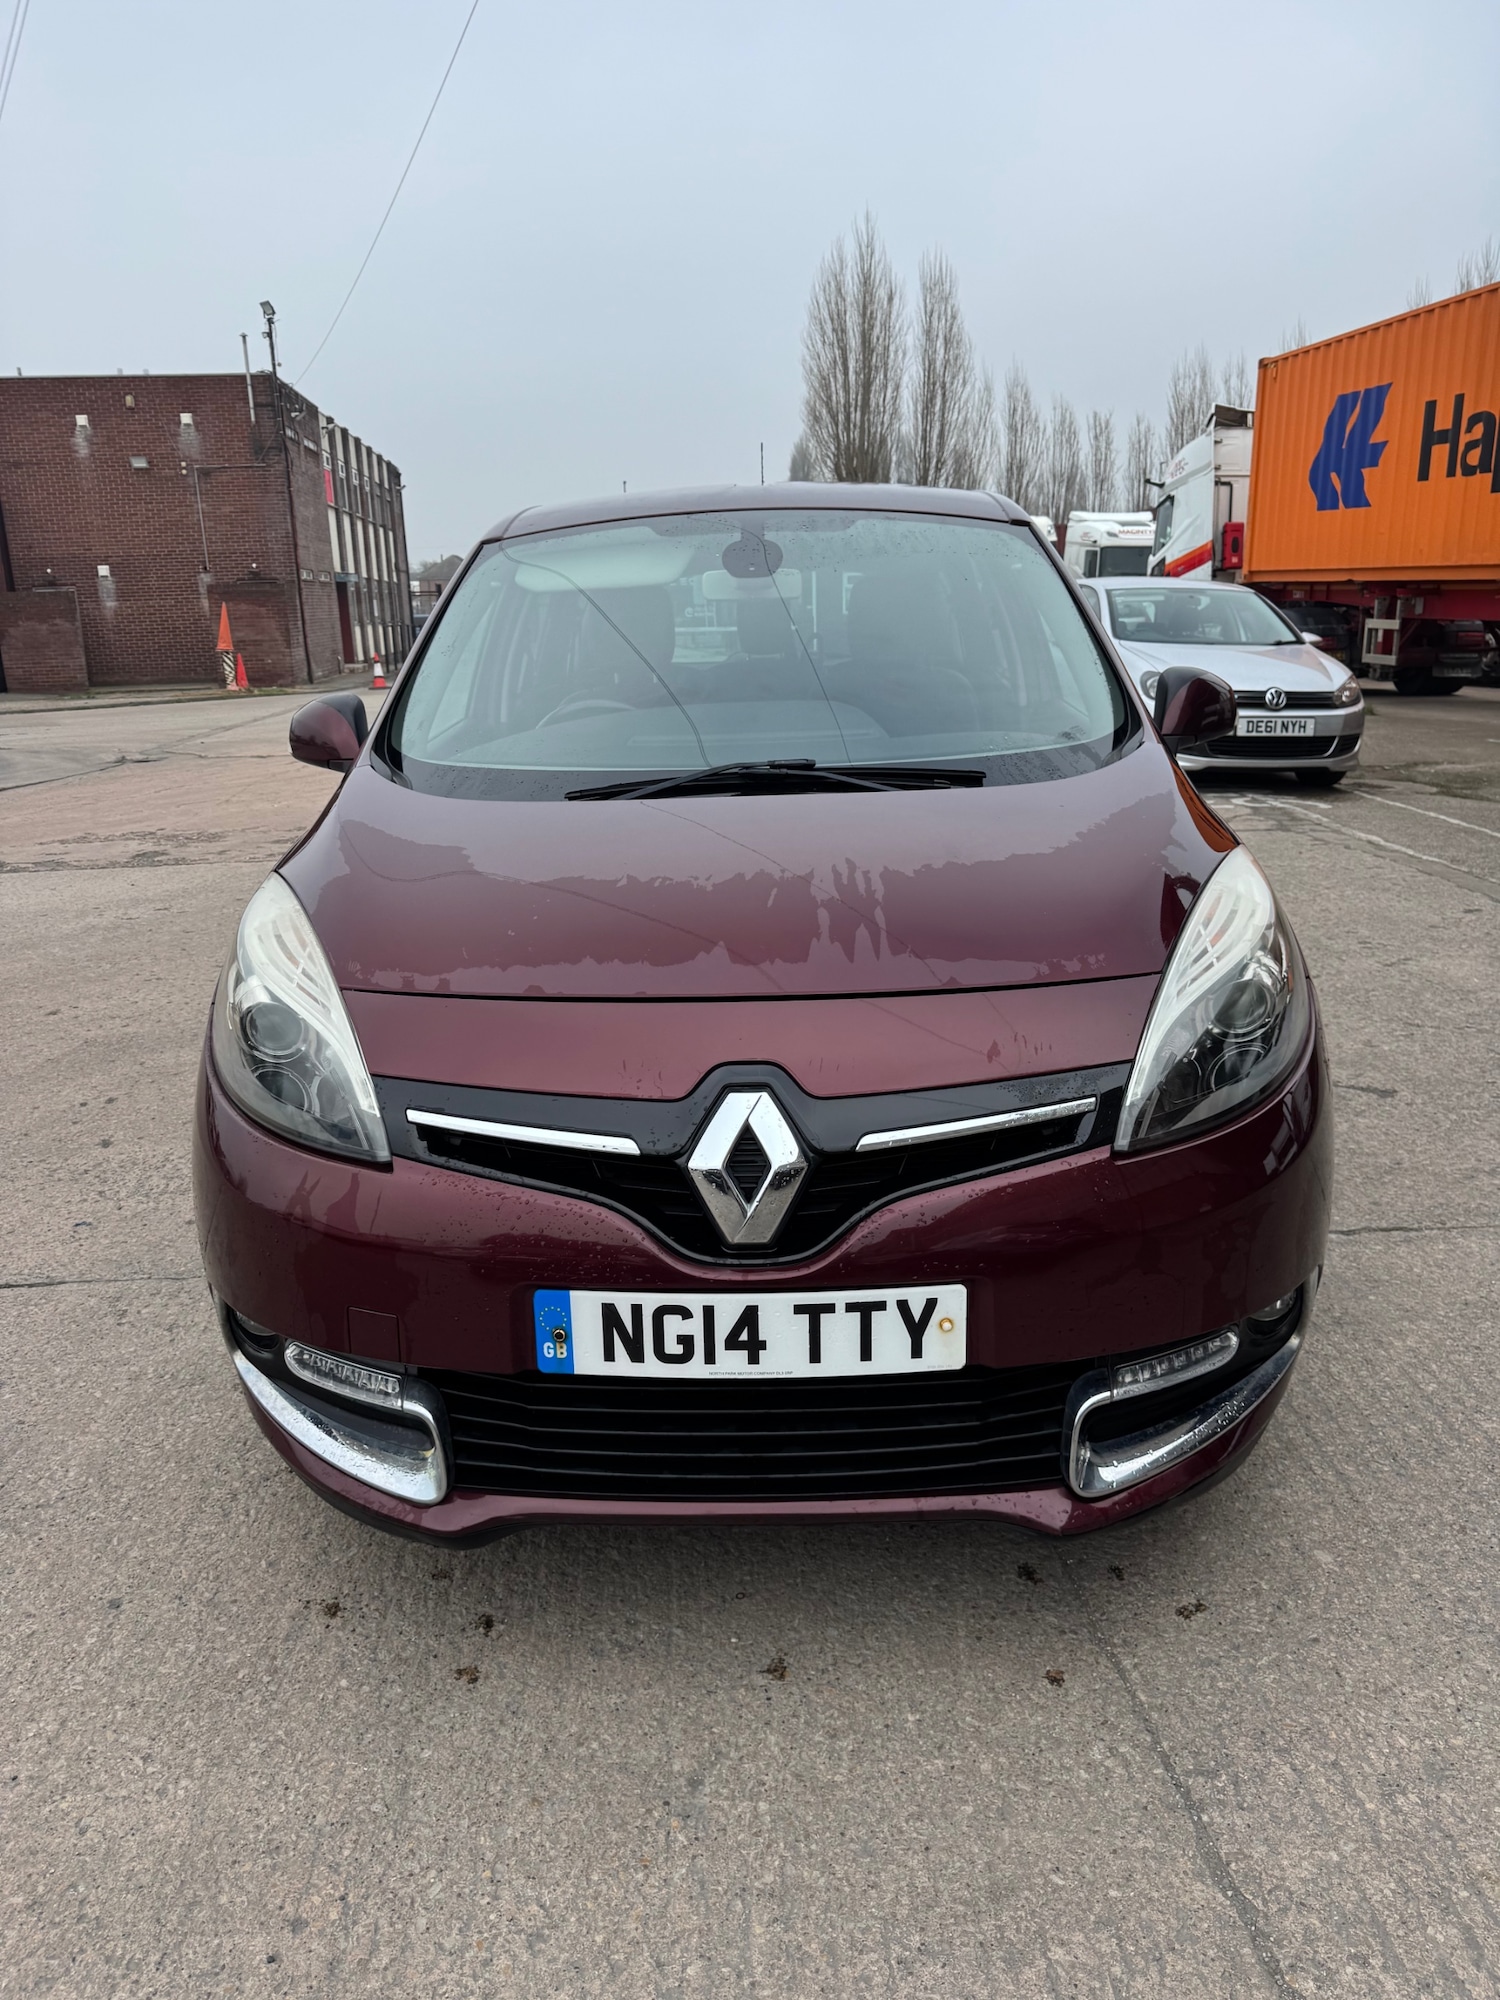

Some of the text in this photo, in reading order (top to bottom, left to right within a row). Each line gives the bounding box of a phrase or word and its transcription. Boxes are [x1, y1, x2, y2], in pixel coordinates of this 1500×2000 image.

[1246, 720, 1307, 733] DE61 NYH
[601, 1297, 938, 1365] NG14 TTY
[543, 1342, 568, 1359] GB
